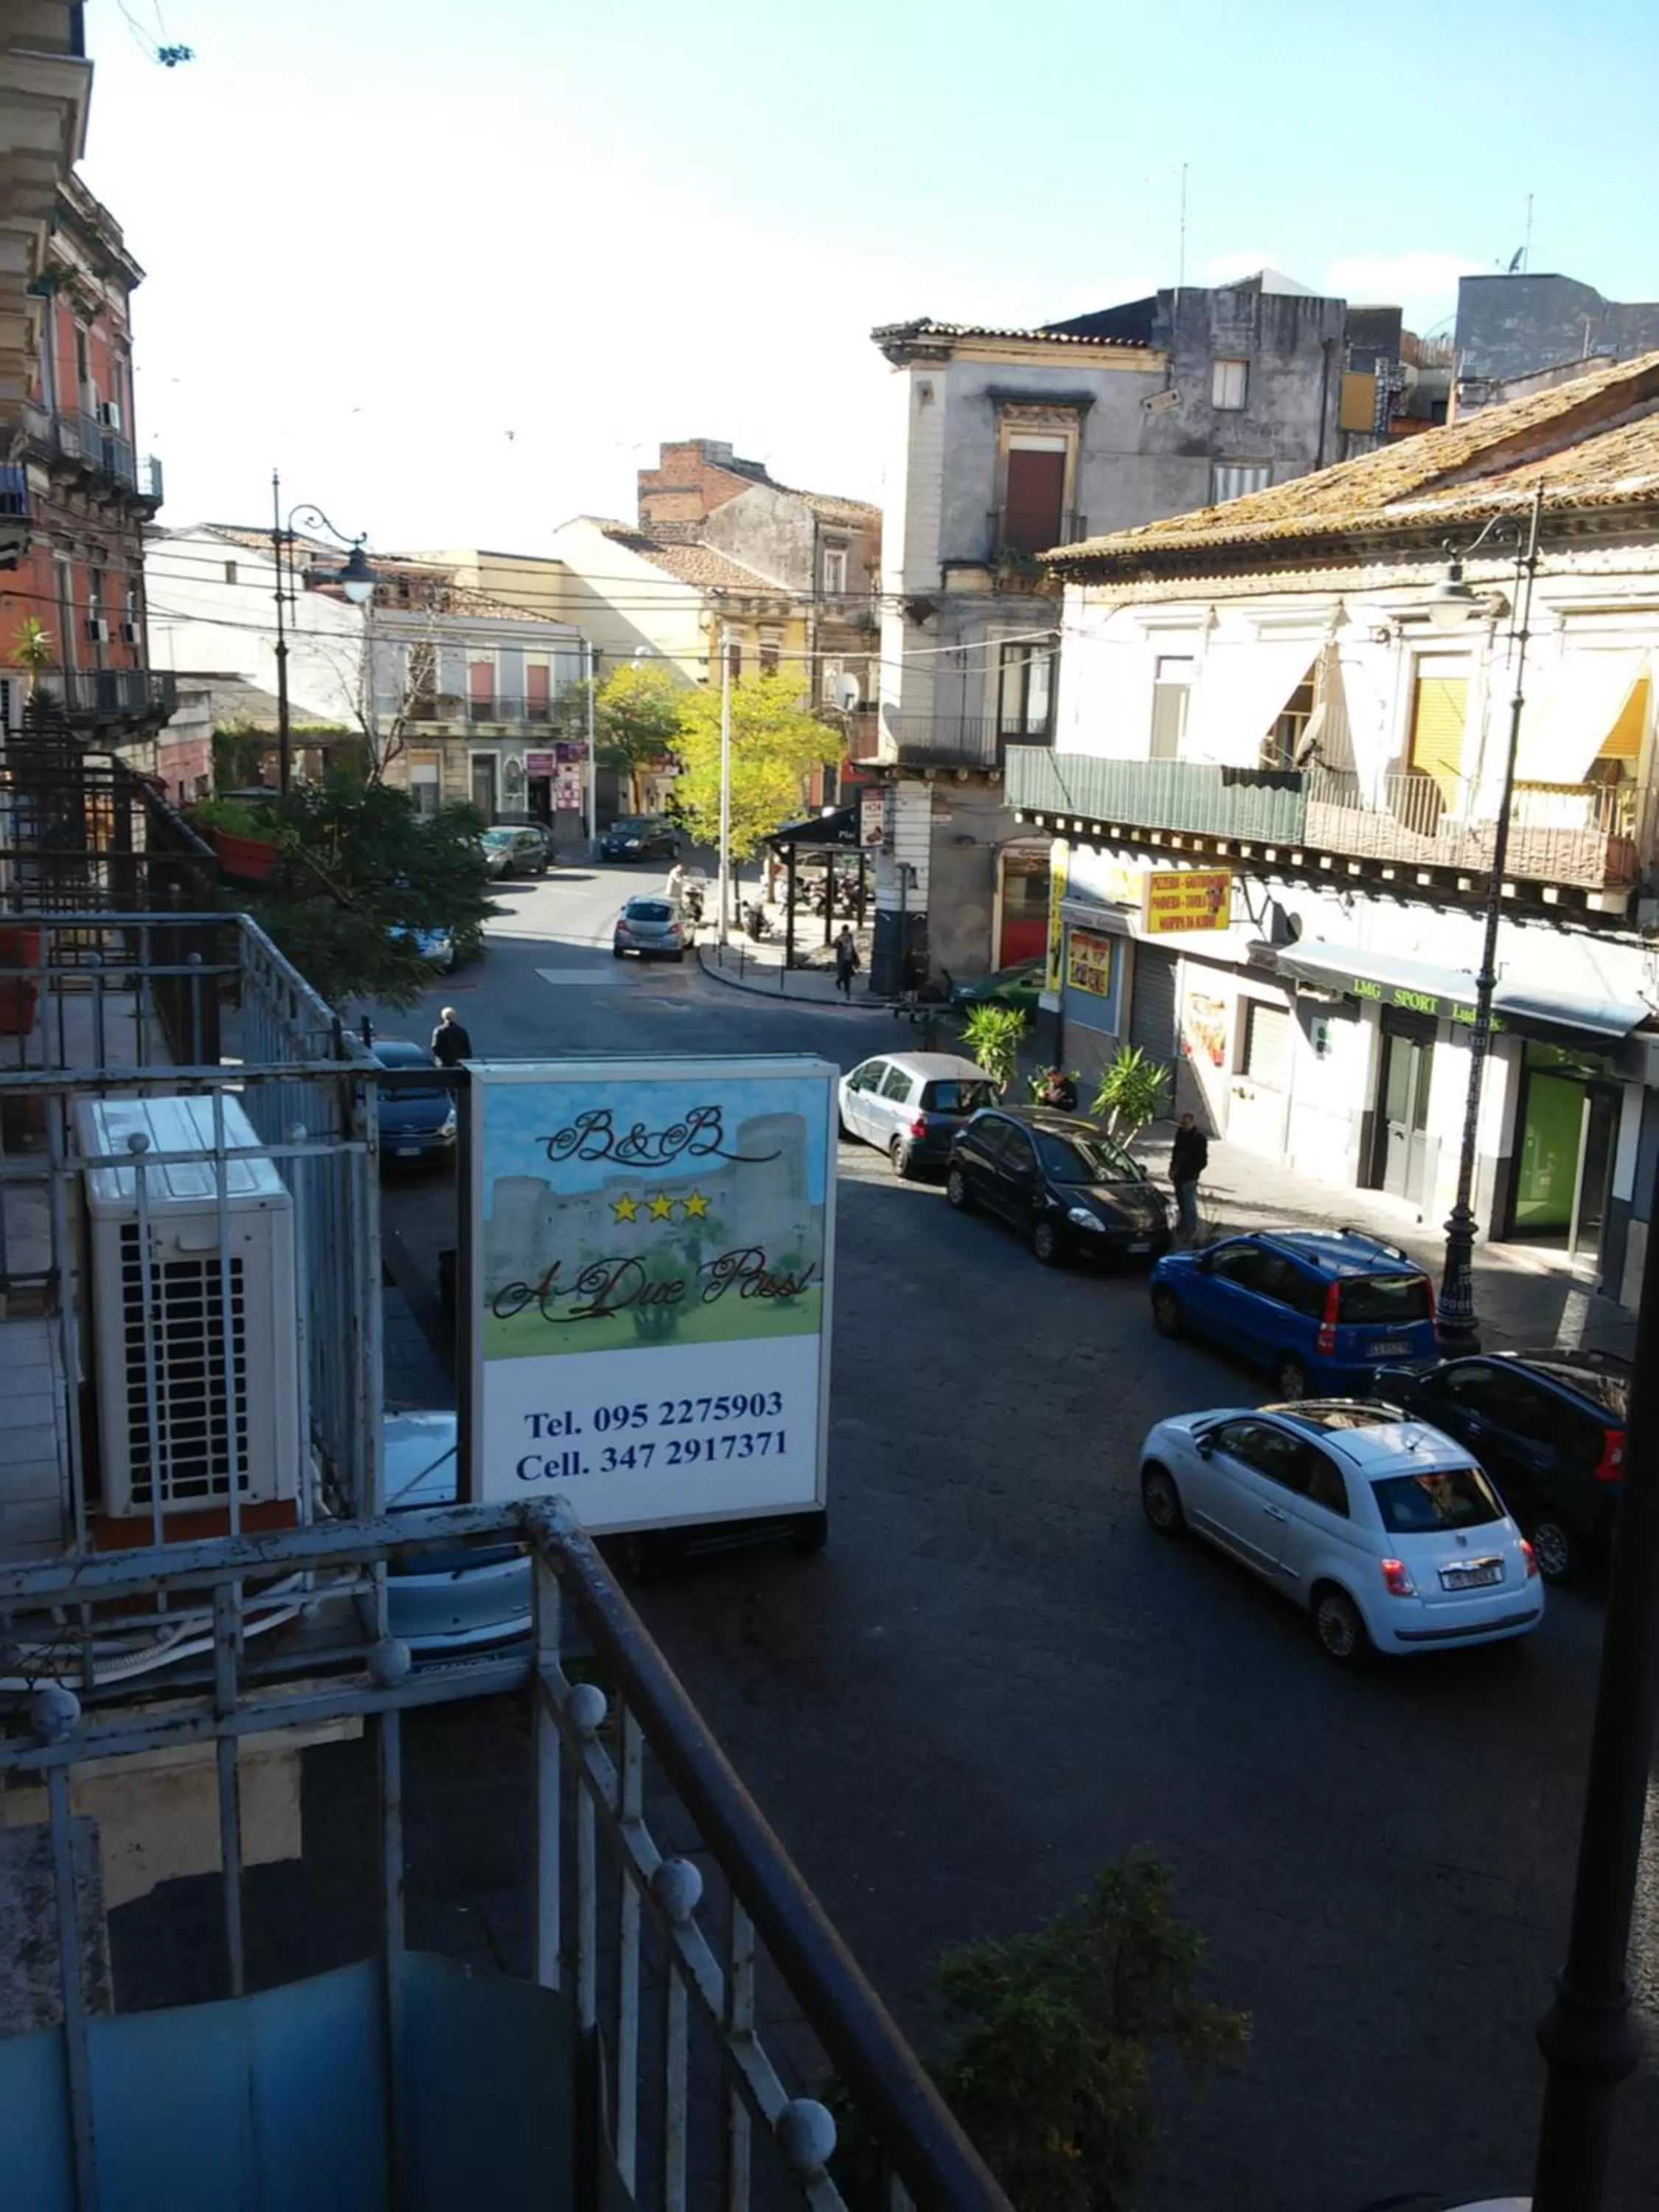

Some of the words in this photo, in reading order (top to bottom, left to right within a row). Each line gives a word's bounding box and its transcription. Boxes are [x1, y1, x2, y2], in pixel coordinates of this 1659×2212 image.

[1353, 978, 1380, 998] LMG
[1394, 989, 1438, 1014] SPORT
[535, 1105, 782, 1167] B&B
[493, 1259, 599, 1323] A
[558, 1256, 685, 1318] Due
[524, 1411, 582, 1439] Tel.
[593, 1402, 649, 1432] 095
[658, 1391, 782, 1426] 2275903
[516, 1450, 590, 1481] Cell.
[599, 1443, 655, 1472] 347
[666, 1430, 787, 1465] 2917371
